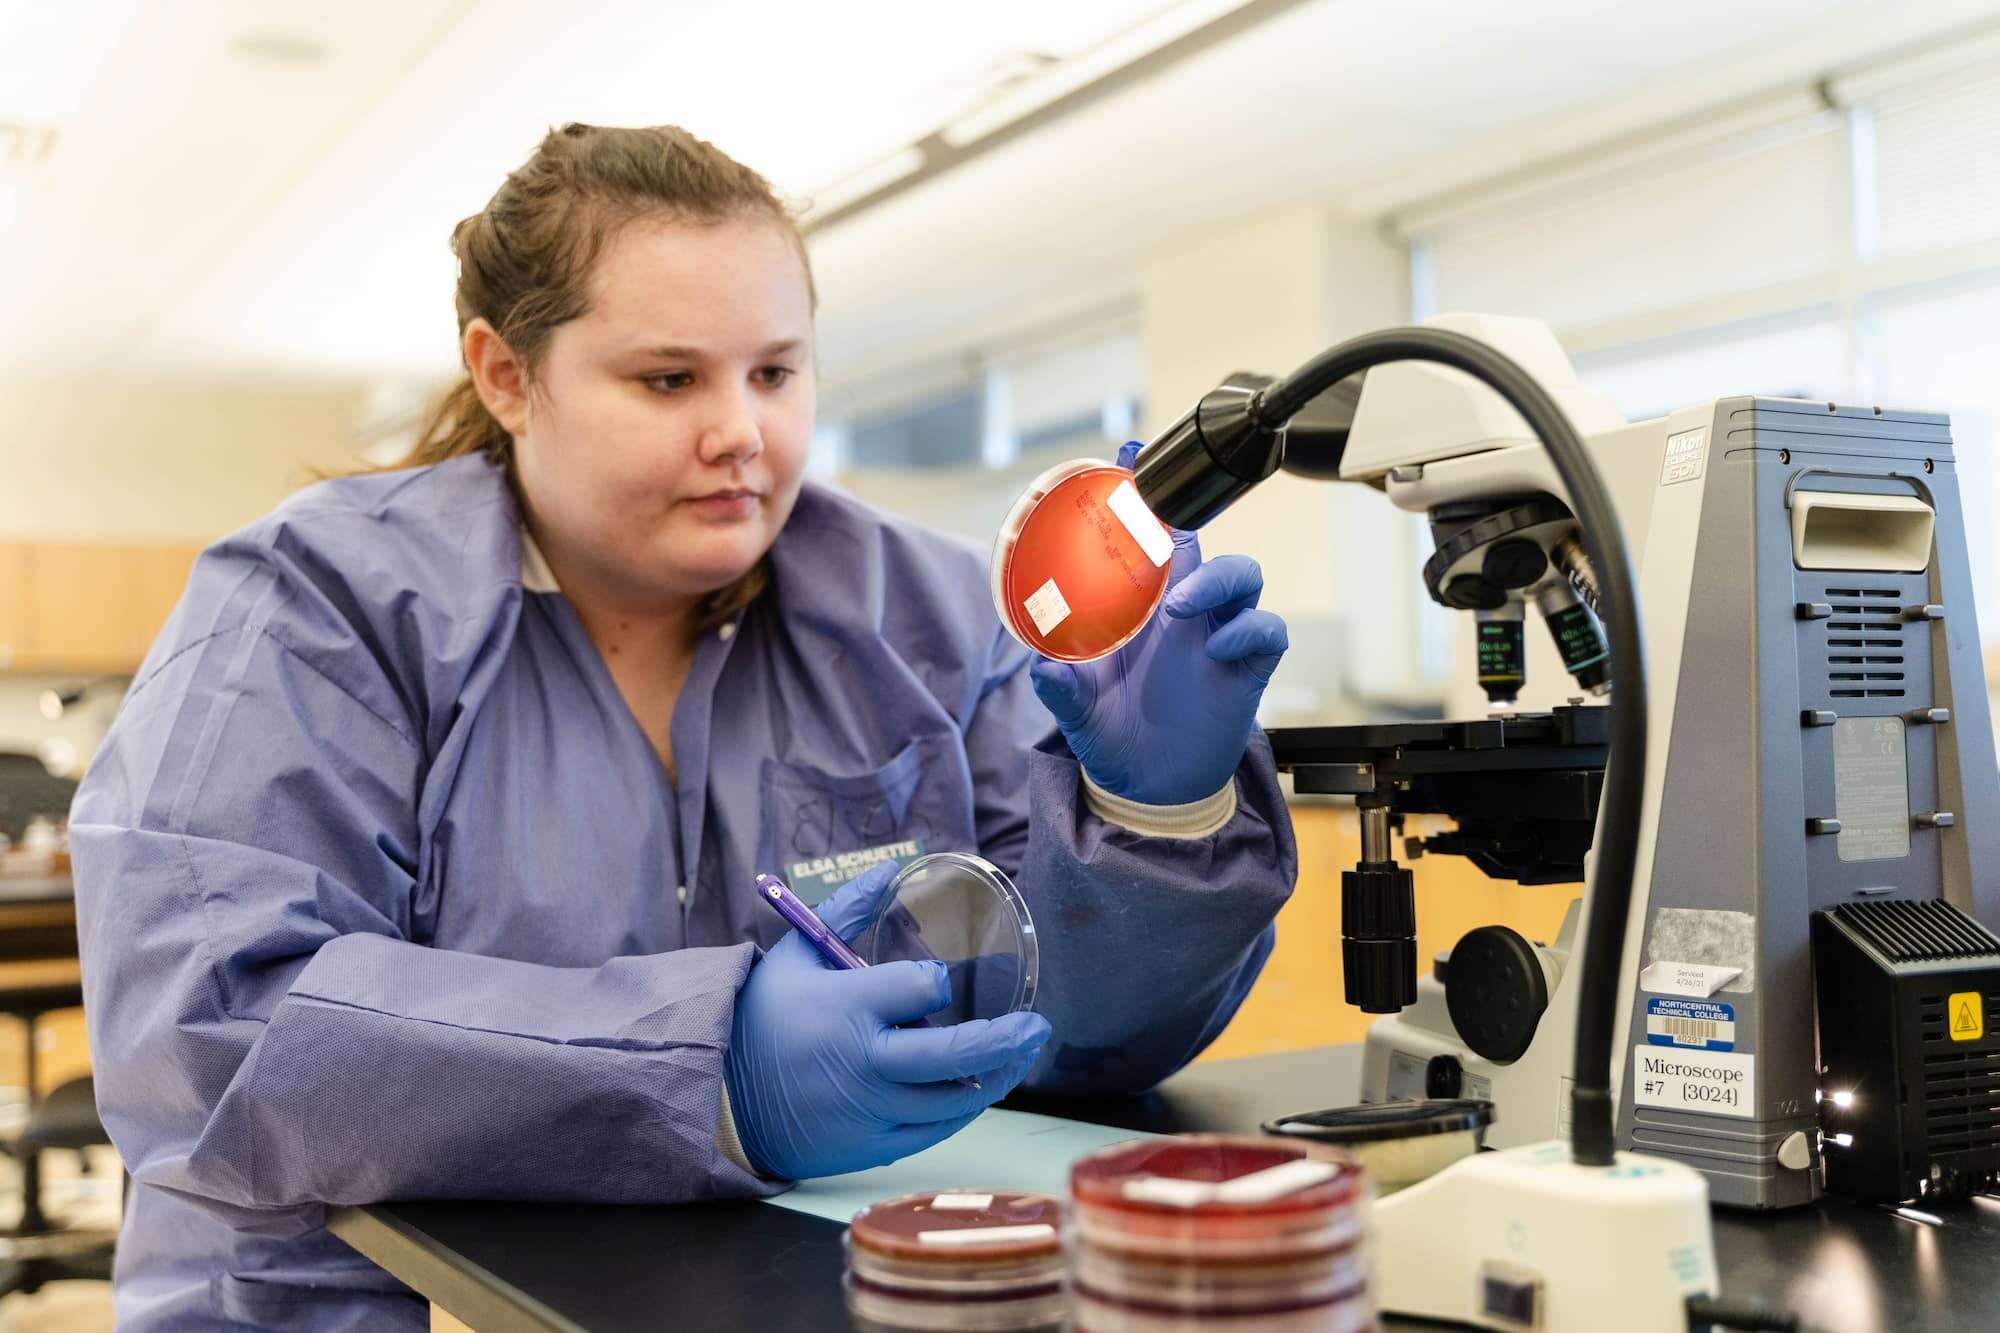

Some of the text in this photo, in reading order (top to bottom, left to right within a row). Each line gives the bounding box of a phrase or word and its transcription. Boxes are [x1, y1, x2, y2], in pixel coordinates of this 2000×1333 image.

[1668, 435, 1704, 457] Nikon
[793, 857, 836, 879] ELSA
[836, 839, 919, 868] SCHUETTE
[1677, 968, 1704, 978] Serviced
[1652, 1007, 1729, 1020] TECHNICAL COLLEGE
[1659, 1000, 1722, 1012] NORTHCENTRAL
[1644, 1057, 1744, 1083] Microscope
[1644, 1080, 1738, 1107] #7 (3024)
